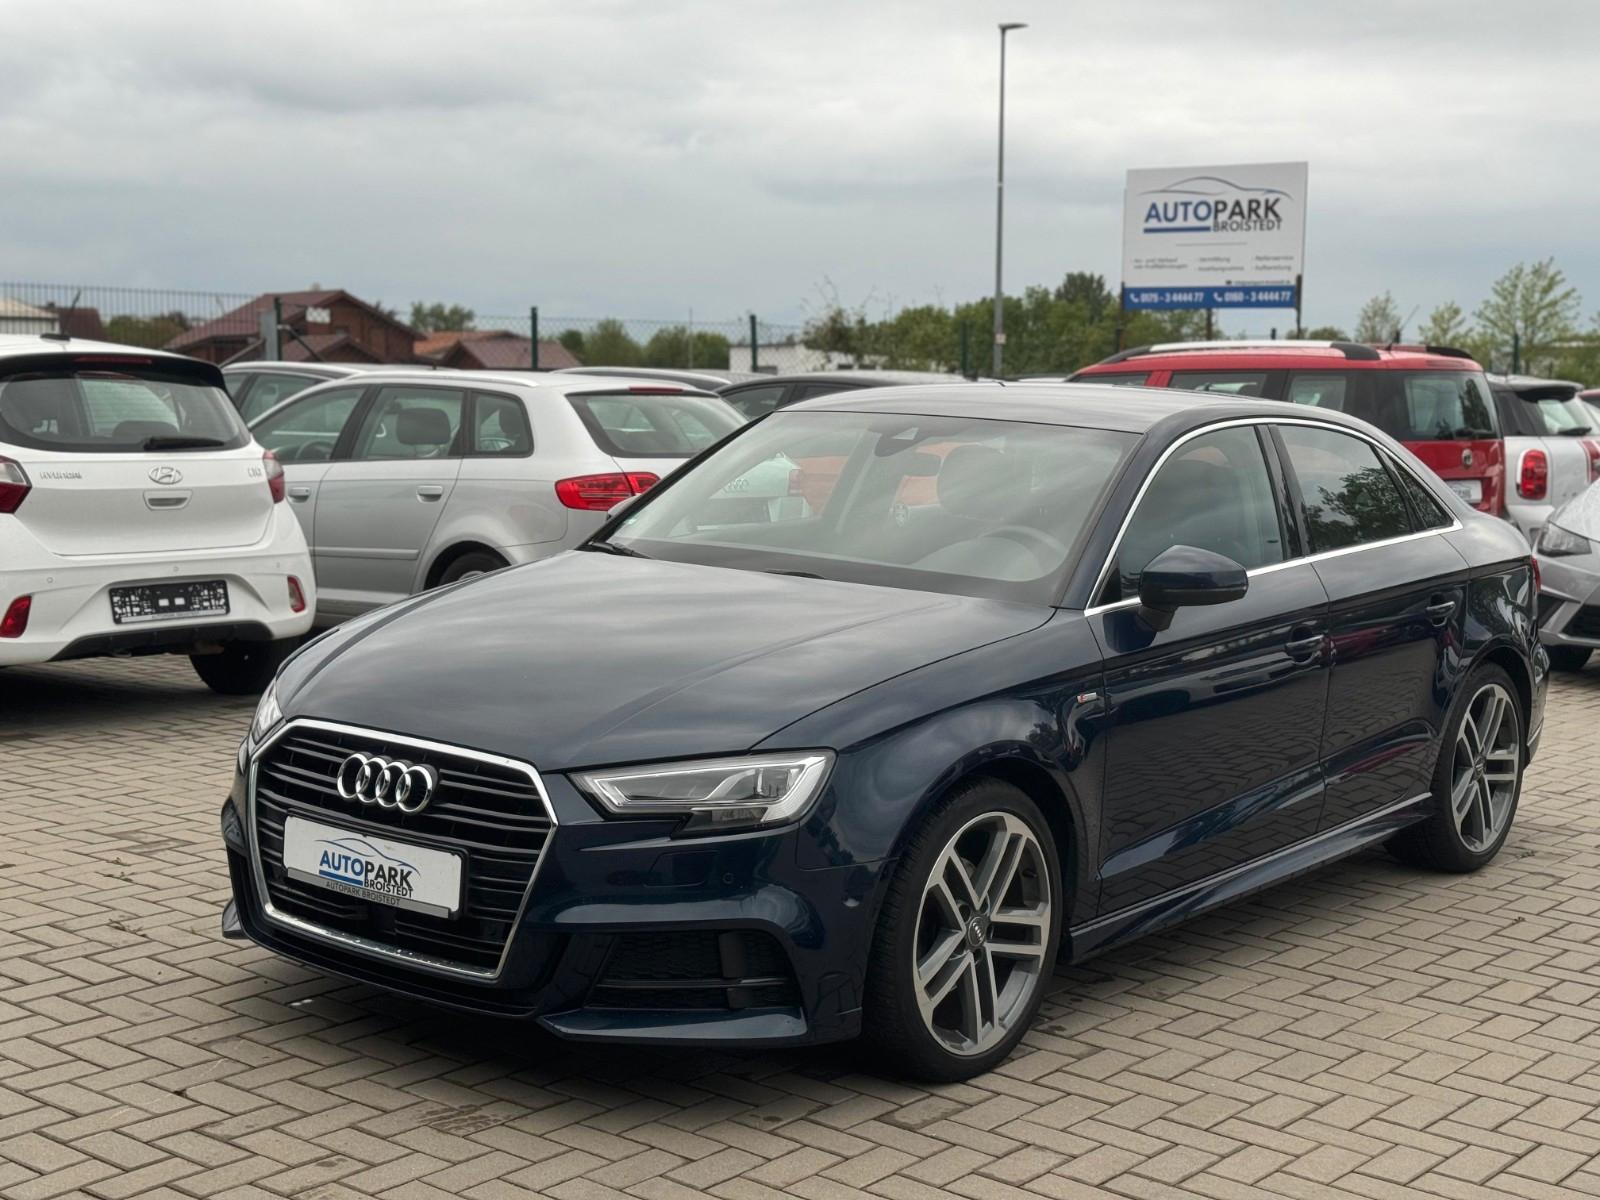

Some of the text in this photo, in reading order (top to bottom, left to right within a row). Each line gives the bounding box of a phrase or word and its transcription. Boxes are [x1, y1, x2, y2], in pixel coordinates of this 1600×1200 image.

[1144, 198, 1282, 222] AUTOPARK
[1212, 219, 1281, 232] BROISTEDT
[319, 850, 413, 888] AUTOPARK
[326, 881, 400, 904] AUTOPARK BROISTEDT
[364, 878, 413, 899] BROISTEDT
